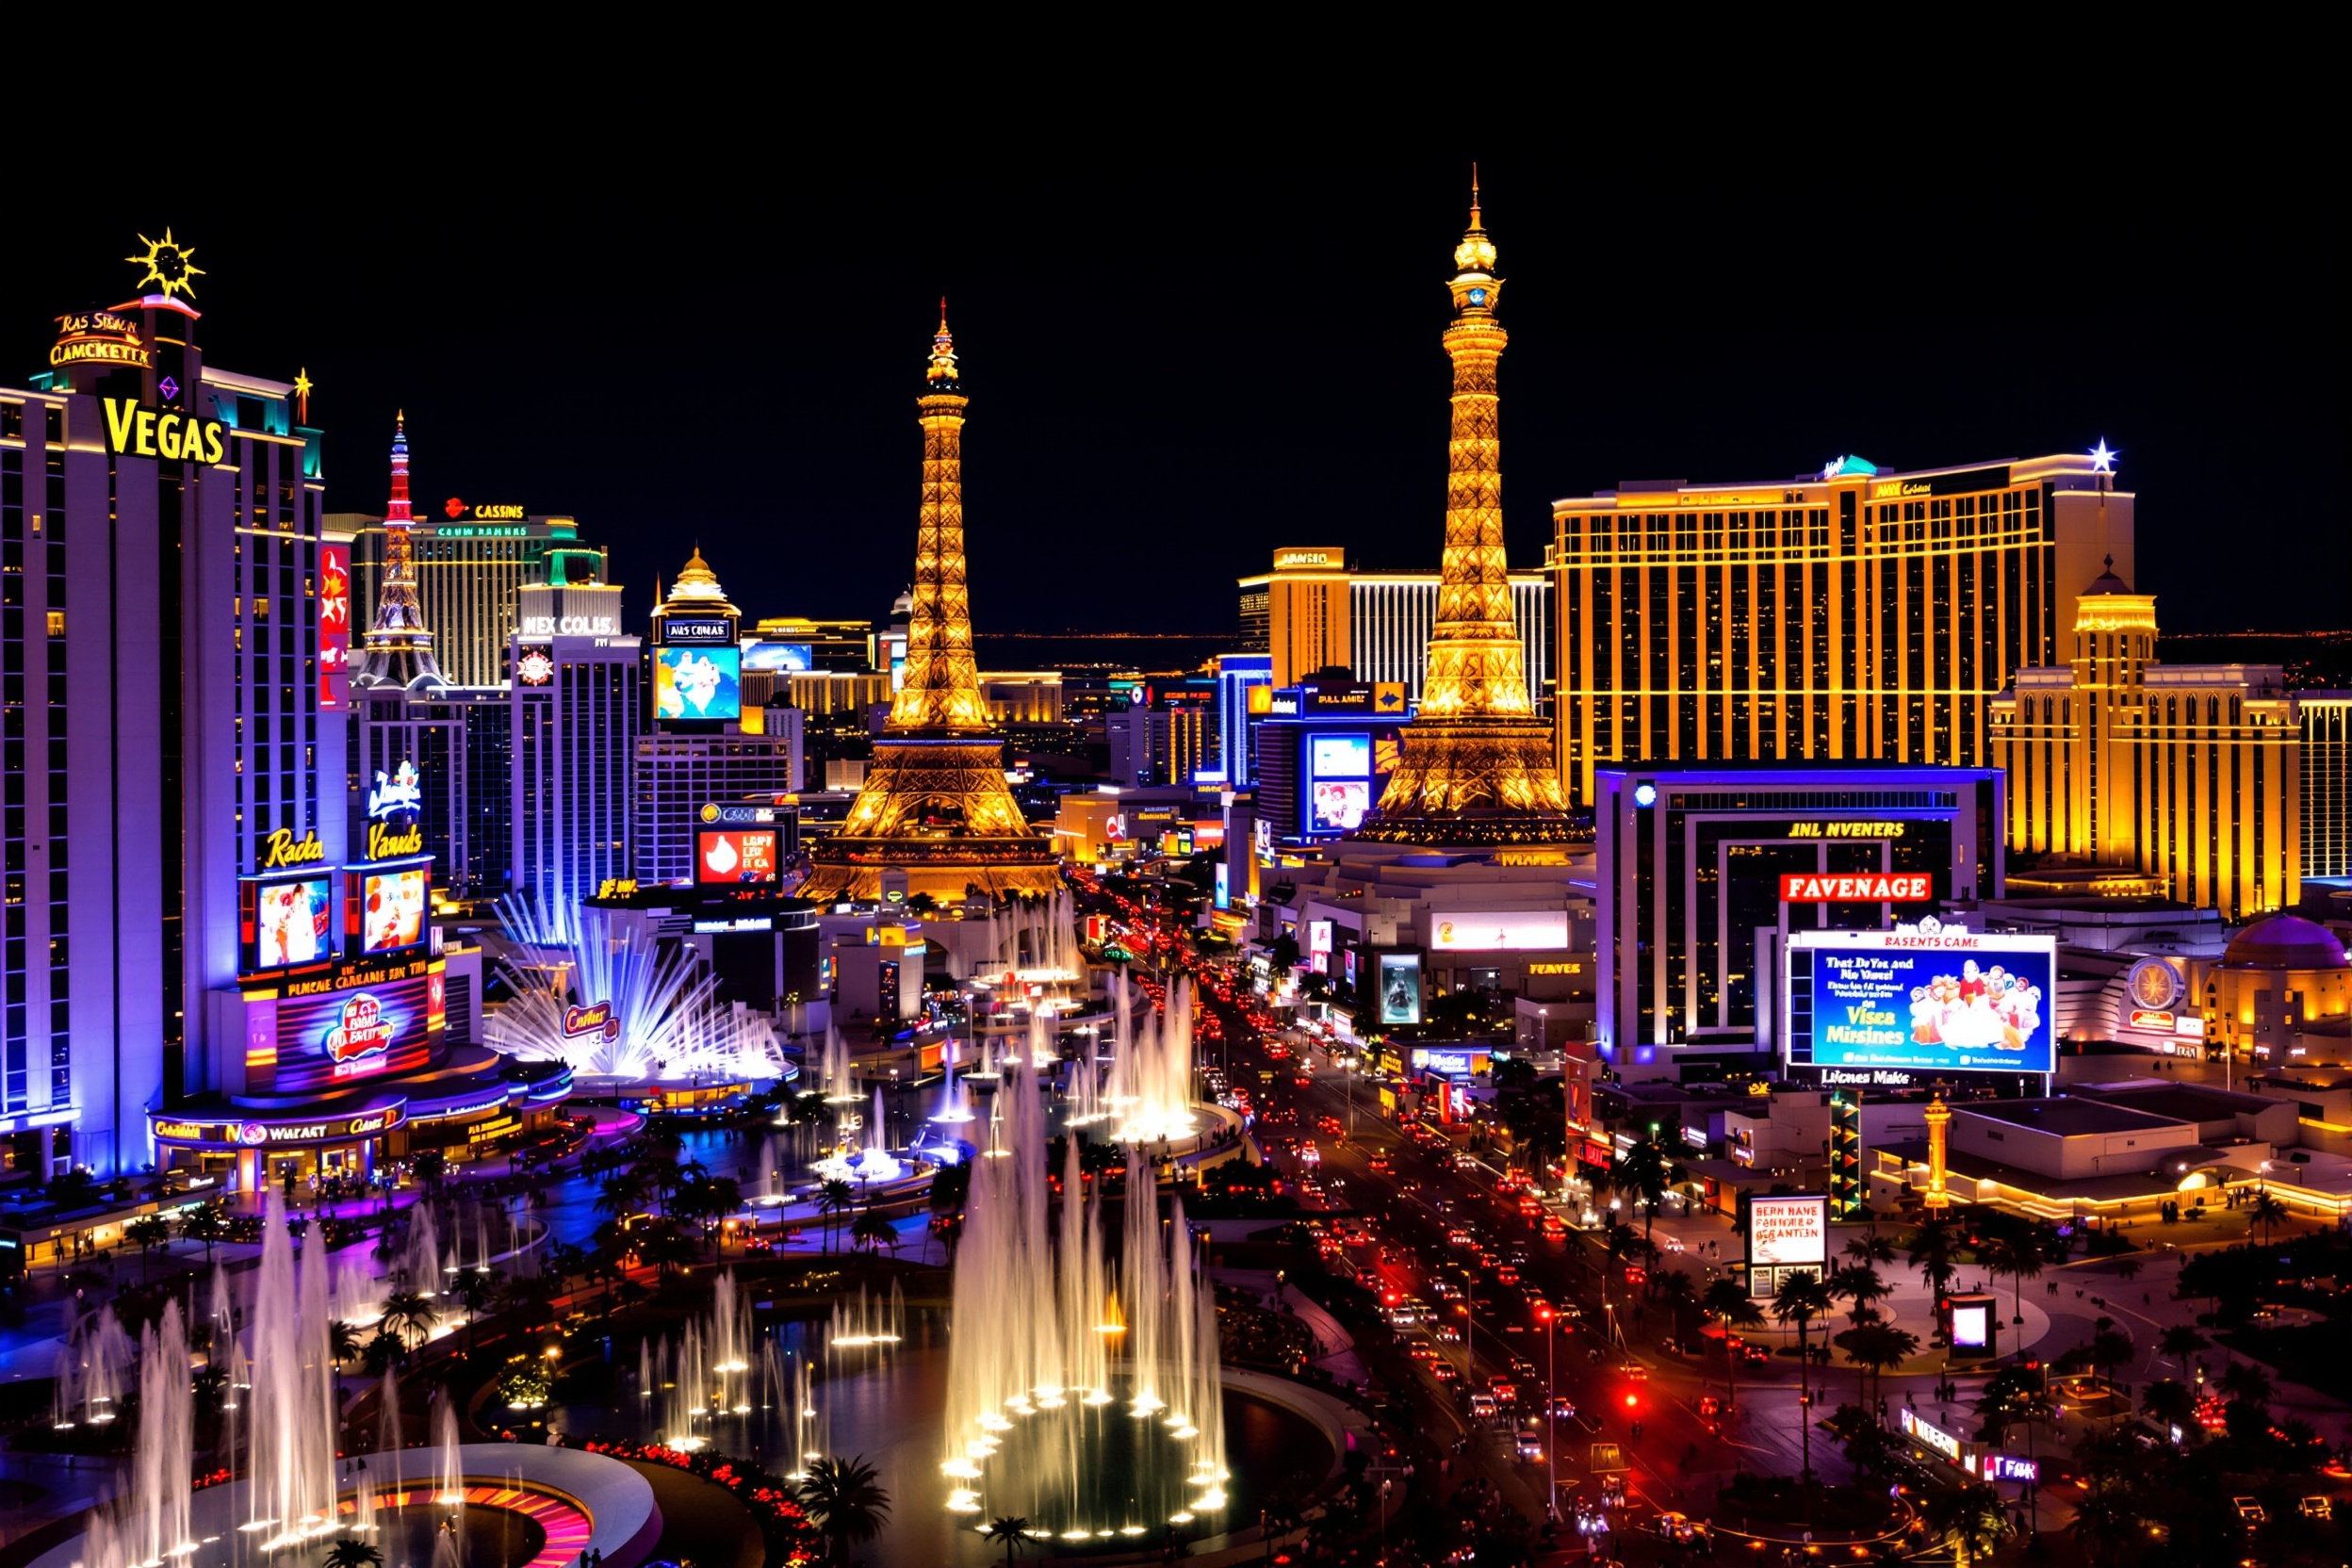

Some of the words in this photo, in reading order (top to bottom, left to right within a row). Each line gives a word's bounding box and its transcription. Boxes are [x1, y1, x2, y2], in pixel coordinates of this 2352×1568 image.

[104, 398, 224, 464] VEGAS
[1788, 878, 1926, 897] FAVENAGE
[1886, 937, 1941, 947] RASENTS
